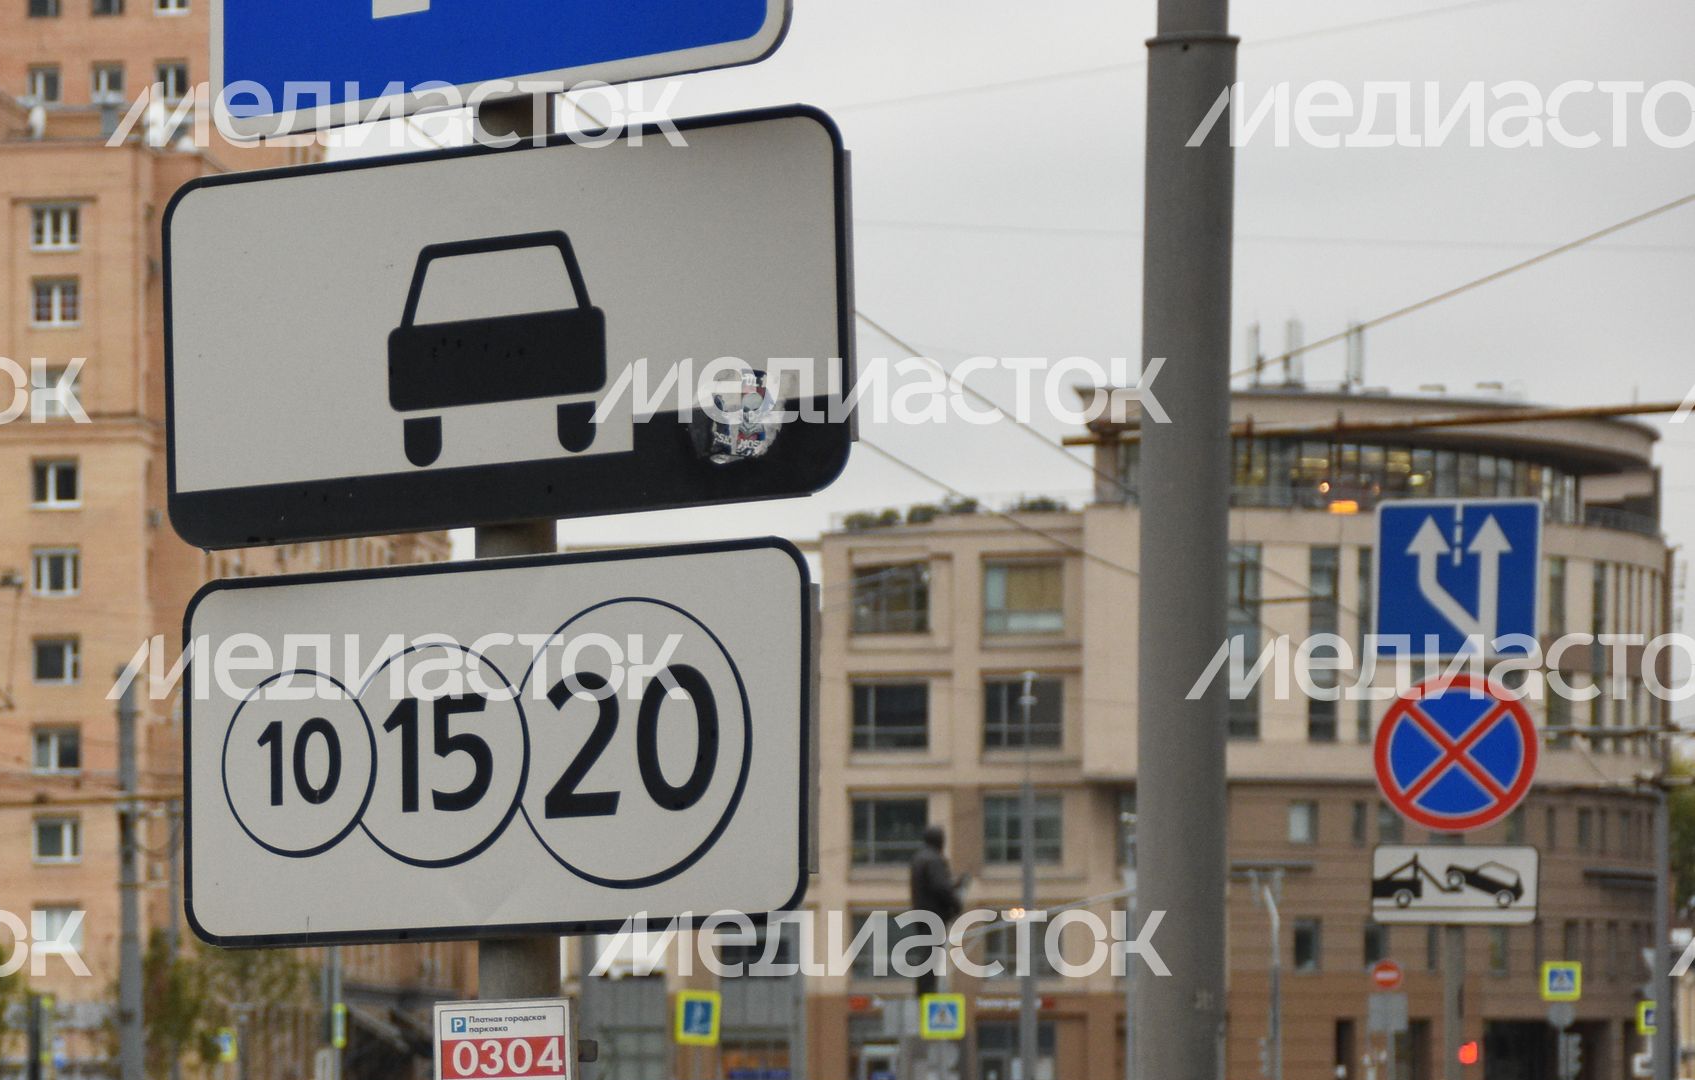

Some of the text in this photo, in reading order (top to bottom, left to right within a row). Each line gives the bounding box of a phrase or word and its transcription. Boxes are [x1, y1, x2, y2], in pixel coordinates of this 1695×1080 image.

[257, 663, 719, 820] 10 15 20
[469, 1016, 503, 1024] Платная
[504, 1014, 546, 1023] городская
[469, 1026, 508, 1034] парковка
[452, 1037, 563, 1077] 0304
